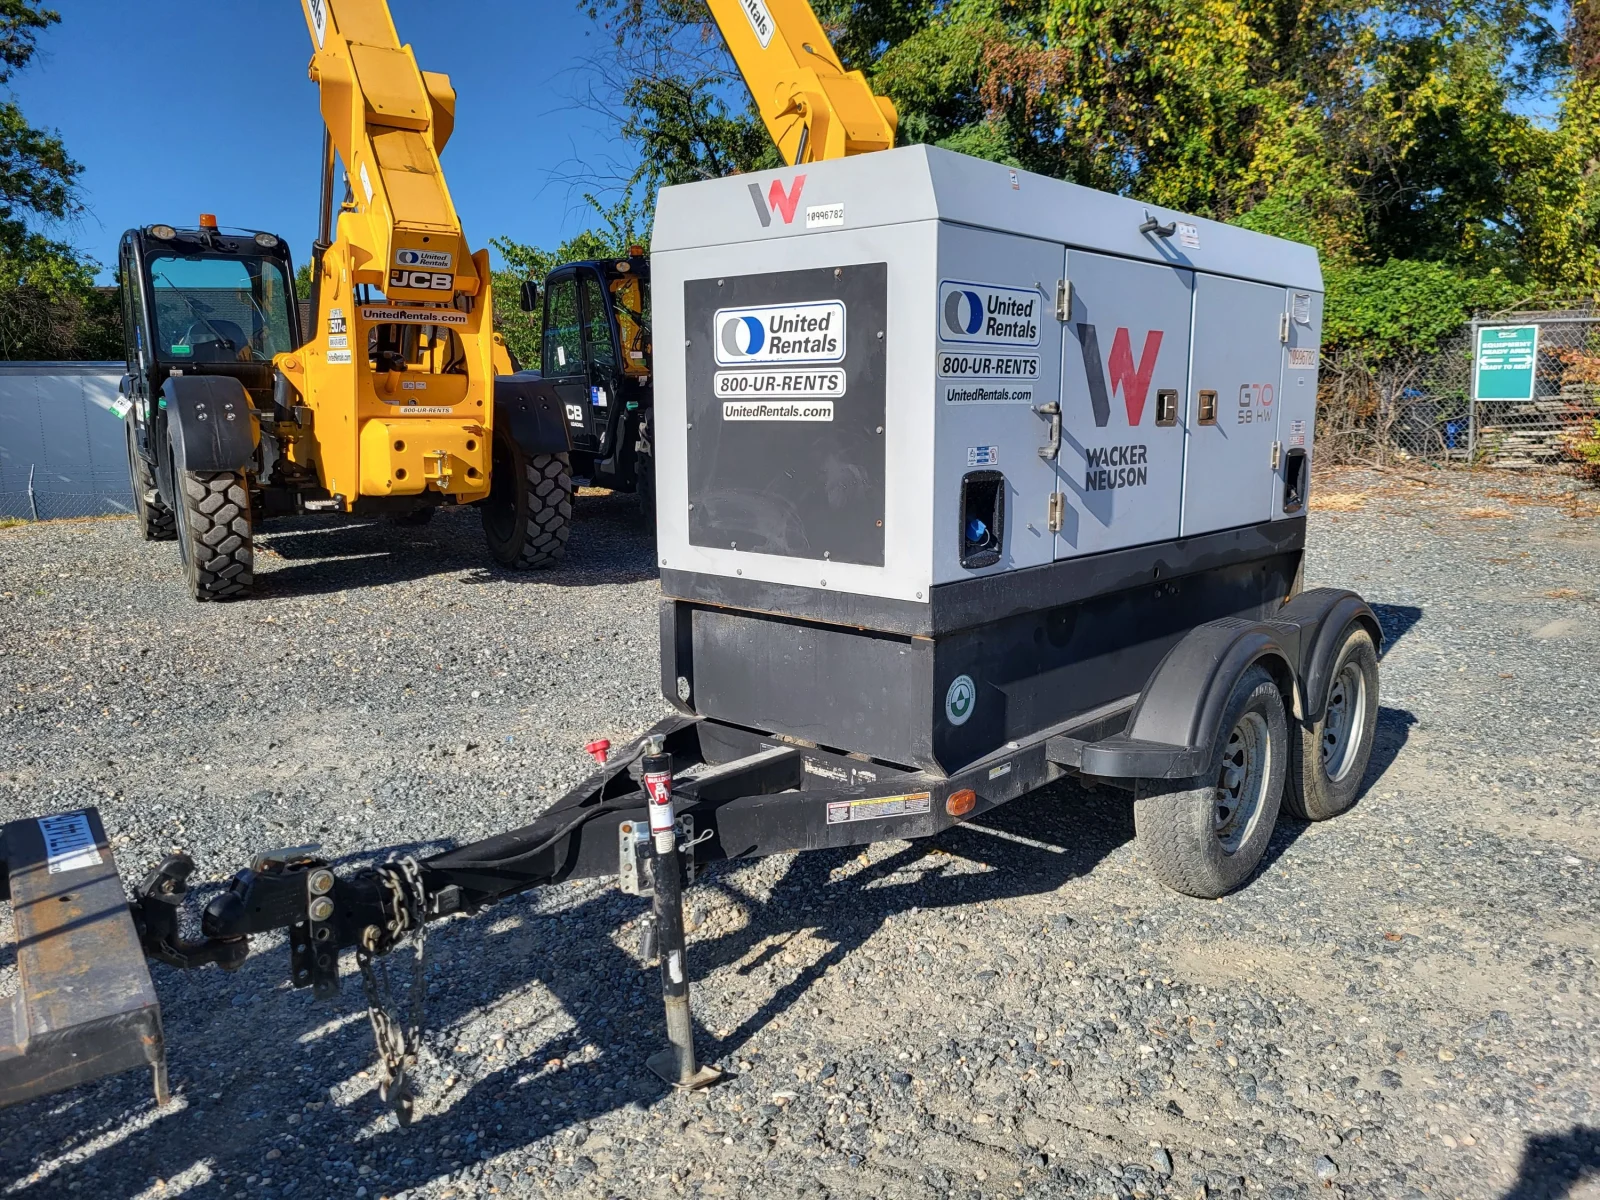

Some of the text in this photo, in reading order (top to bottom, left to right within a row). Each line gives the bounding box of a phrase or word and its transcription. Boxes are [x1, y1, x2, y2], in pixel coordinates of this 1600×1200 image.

[807, 210, 844, 222] 10996782
[420, 259, 448, 267] Rentals
[421, 253, 447, 262] United
[391, 272, 451, 289] JCB
[987, 295, 1033, 317] United
[363, 310, 466, 323] UnitedRentals.com
[769, 312, 831, 333] United
[986, 317, 1036, 338] Rentals
[769, 334, 836, 354] Rentals
[943, 357, 1037, 375] 800-UR-RENTS
[720, 375, 839, 392] 800-UR-RENTS
[947, 388, 1031, 402] UnitedRentals.com
[1239, 384, 1273, 407] G70
[725, 404, 831, 418] UnitedRentals.com
[1086, 445, 1148, 467] WACKER
[1086, 467, 1147, 491] NEUSON
